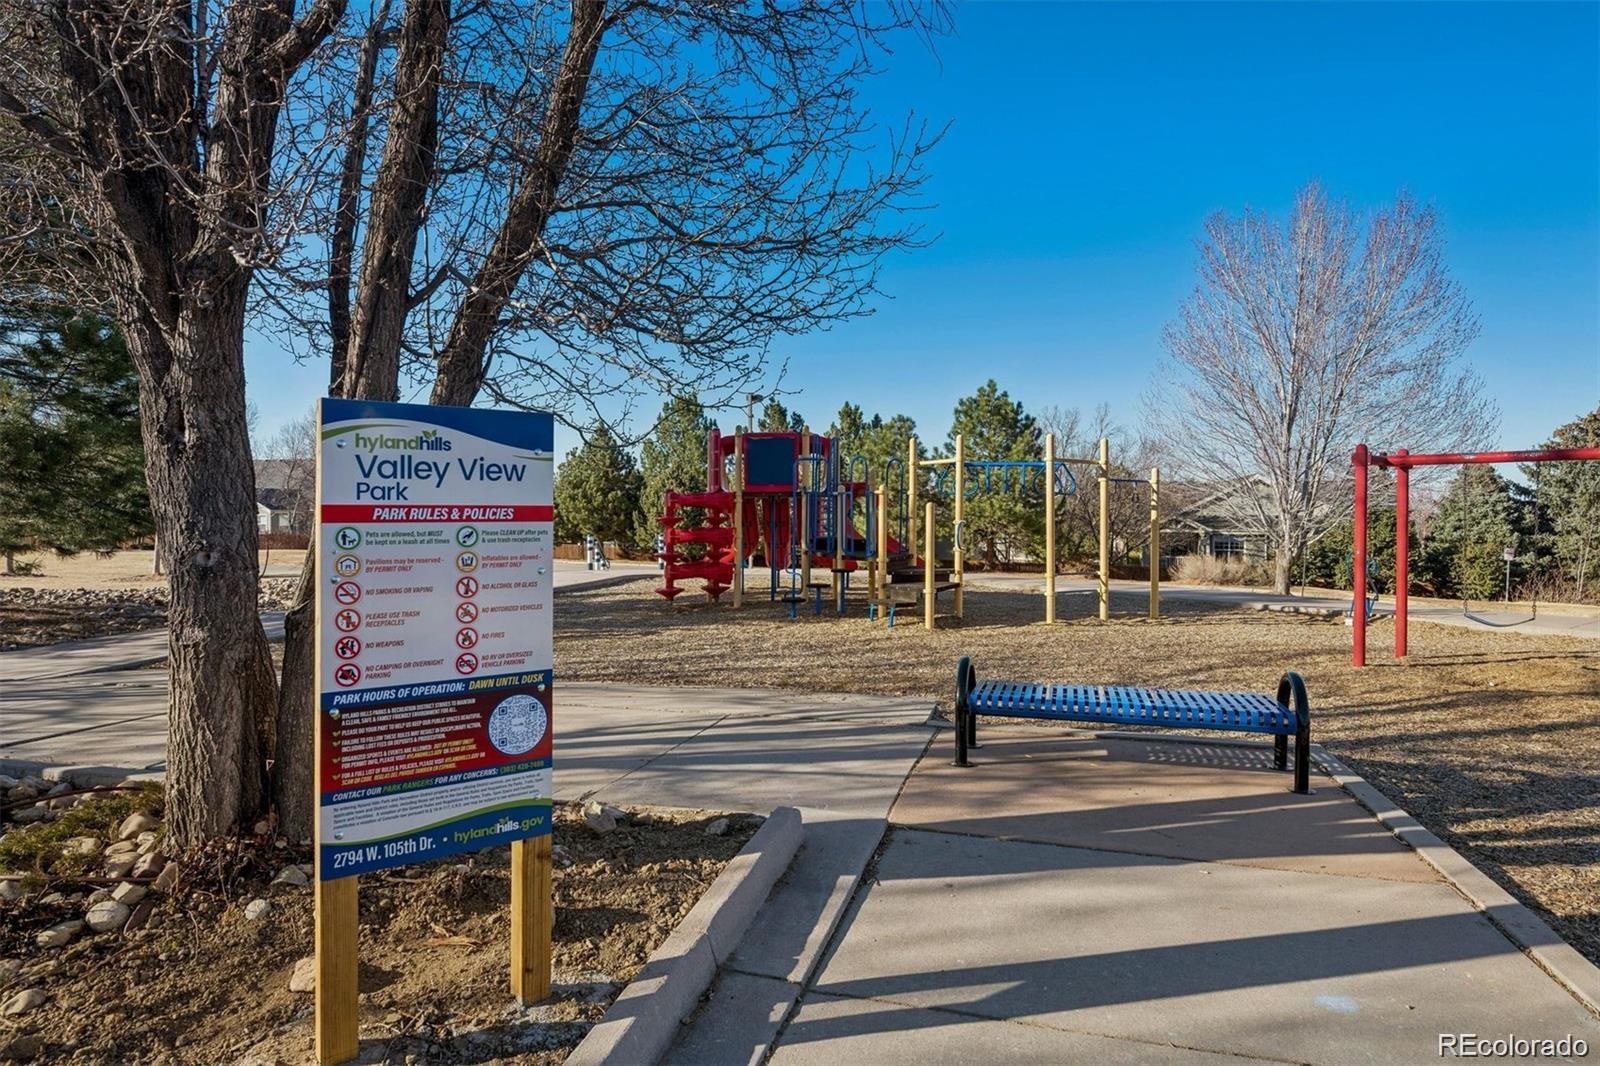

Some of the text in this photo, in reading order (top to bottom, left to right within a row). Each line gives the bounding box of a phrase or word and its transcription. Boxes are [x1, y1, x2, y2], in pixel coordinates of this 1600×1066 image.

[355, 433, 452, 456] hylandhills
[355, 453, 526, 488] Valley View
[357, 481, 408, 501] Park
[373, 507, 514, 520] PARK RULES & POLICIES
[366, 620, 404, 628] RECEPTACLES
[376, 640, 404, 648] WEAPONS
[375, 663, 402, 671] CAMPING
[413, 659, 444, 667] OVERNIGHT
[365, 672, 391, 680] PARKING
[333, 673, 544, 705] PARK HOURS OF OPERATION: DAWN UNTIL DUSK
[332, 789, 367, 801] CONTACT
[367, 787, 382, 796] OUR
[434, 776, 448, 784] FOR
[448, 773, 463, 782] ANY
[463, 768, 499, 779] CONCERNS:
[454, 816, 544, 844] hylandhills.gov
[334, 835, 435, 868] 2794 W. 105th Dr.
